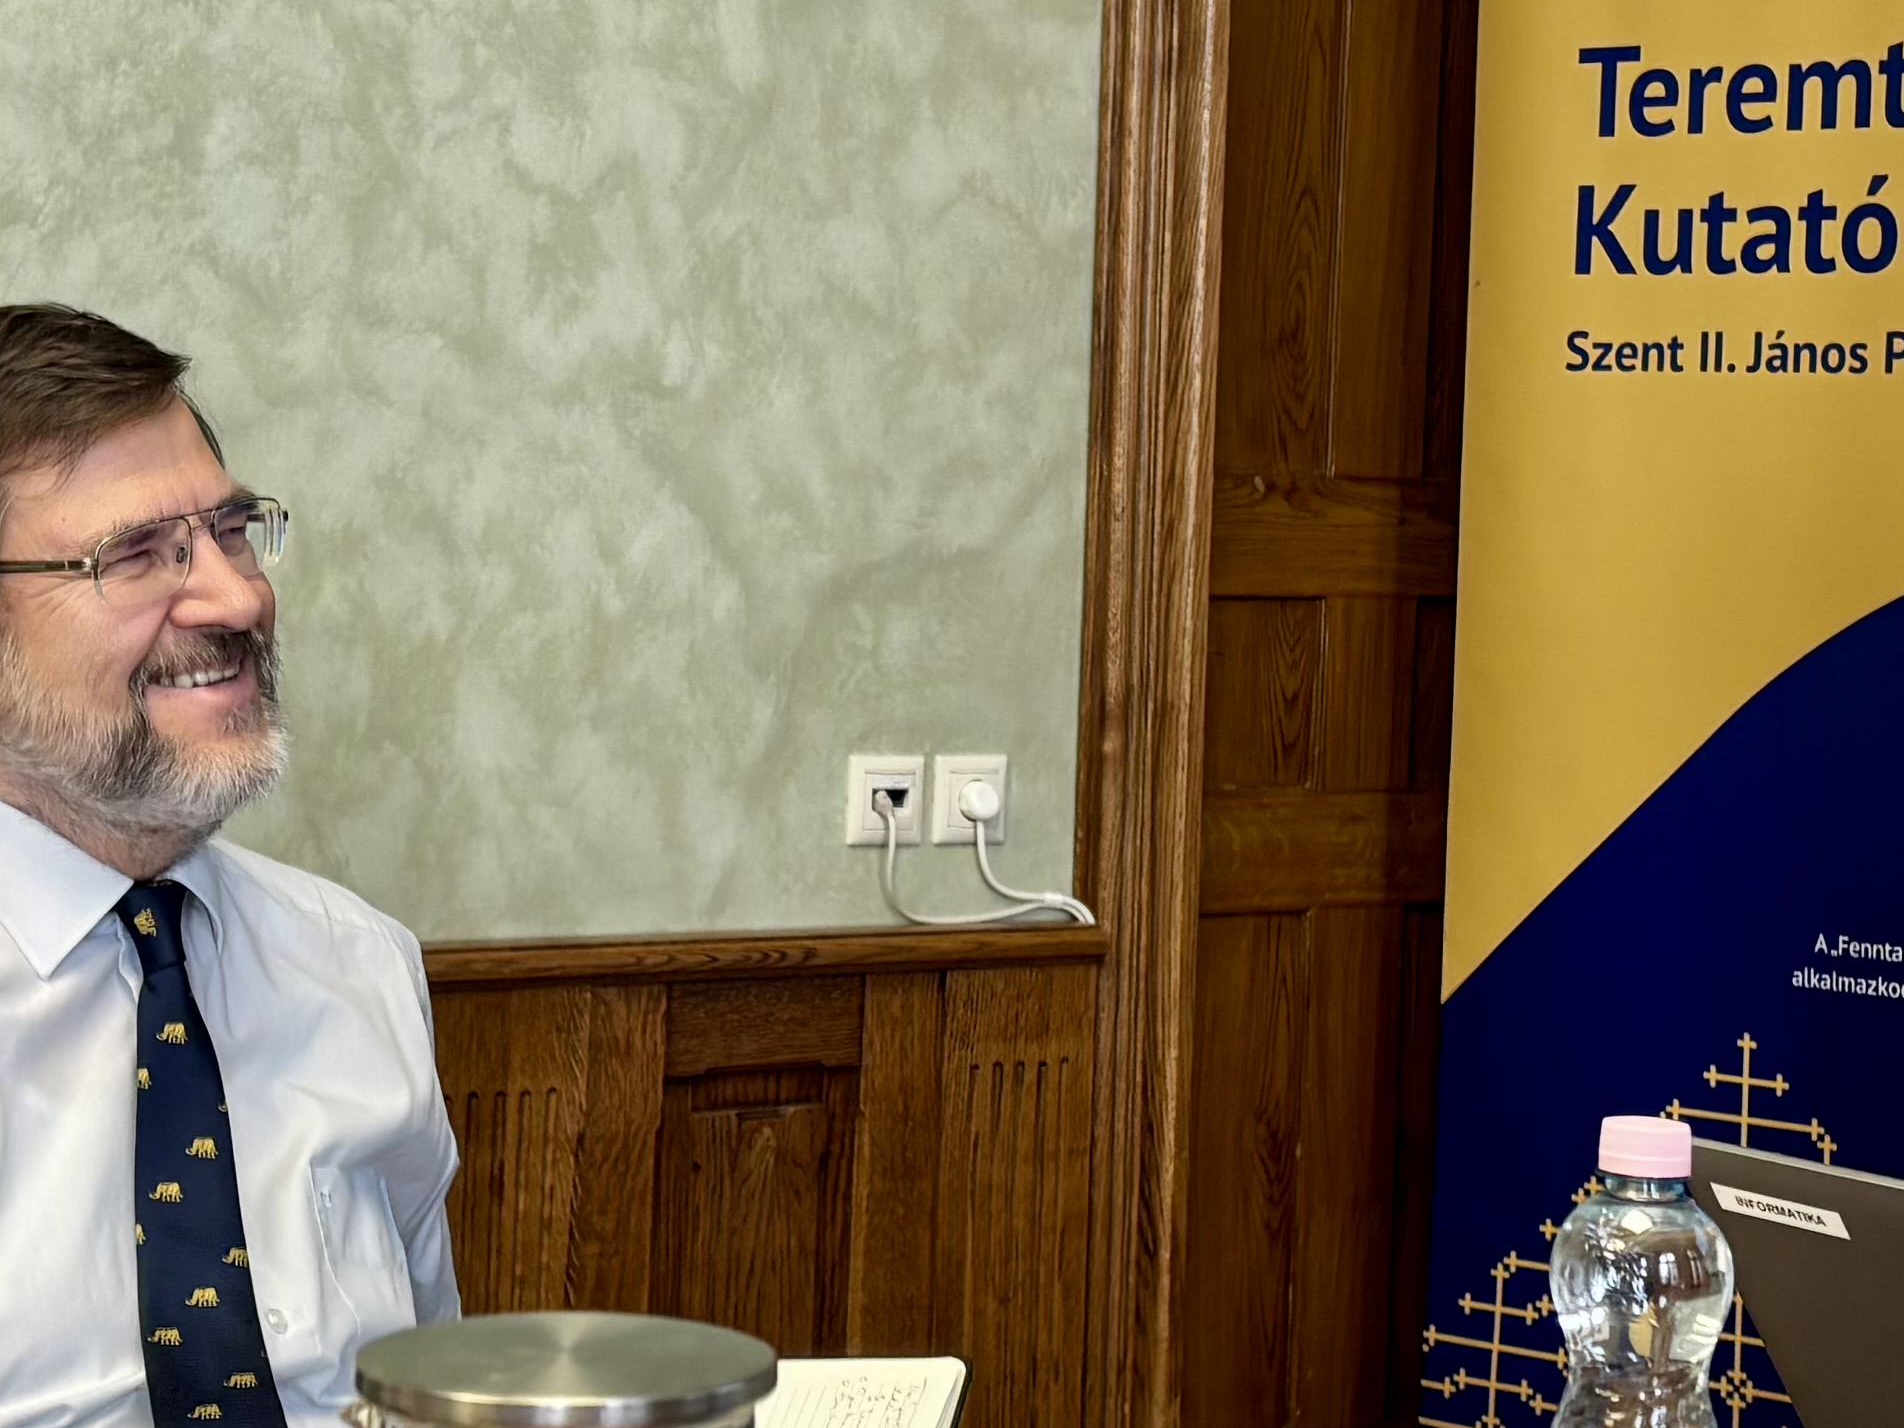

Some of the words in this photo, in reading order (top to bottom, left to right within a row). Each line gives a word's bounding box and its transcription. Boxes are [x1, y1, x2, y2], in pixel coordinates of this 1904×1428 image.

[1565, 331, 1684, 374] Szent
[1699, 332, 1737, 374] II.
[1745, 329, 1869, 376] János
[1734, 1195, 1828, 1227] INFORMATIKA
